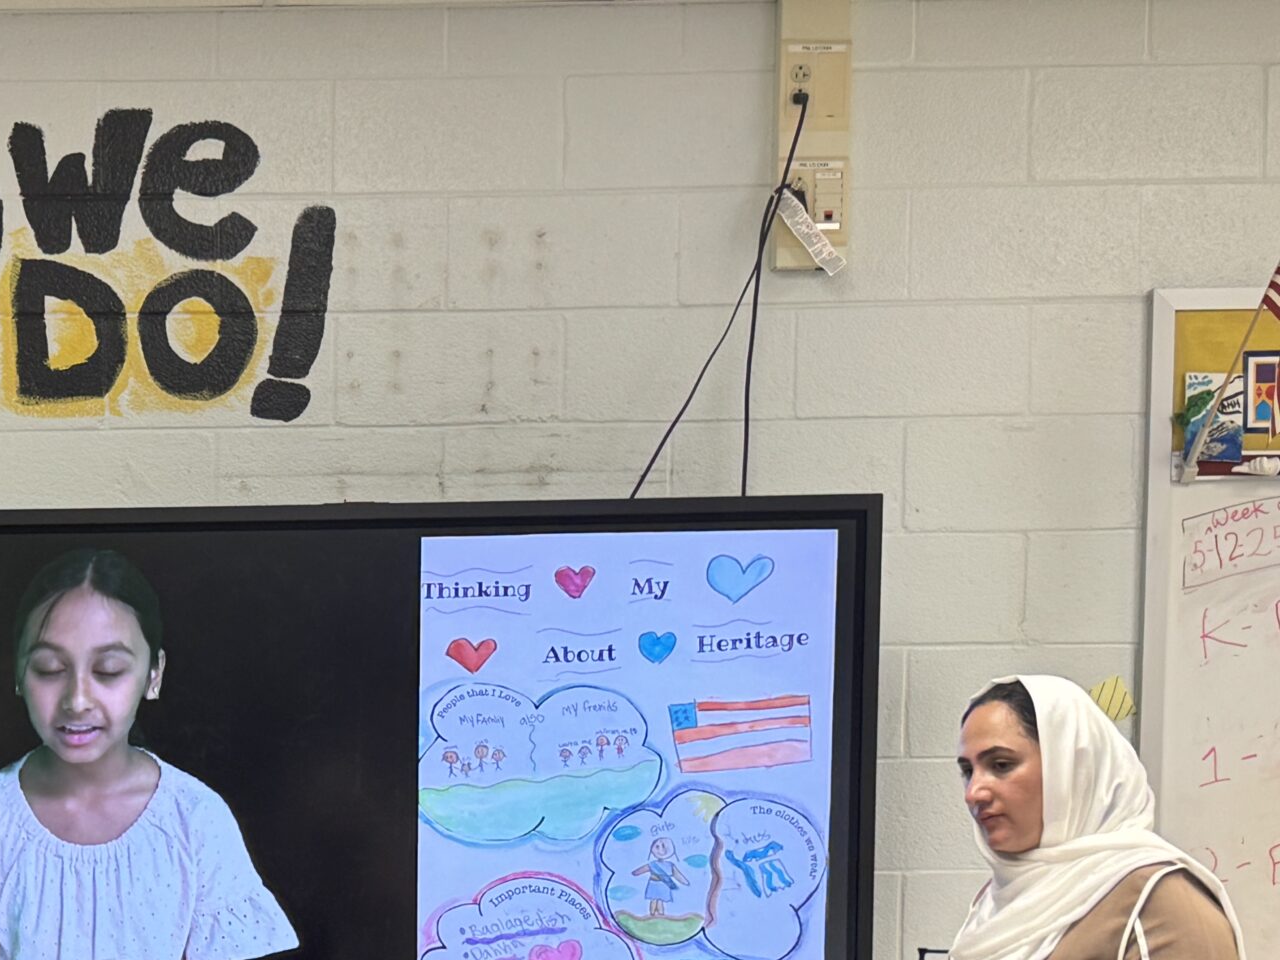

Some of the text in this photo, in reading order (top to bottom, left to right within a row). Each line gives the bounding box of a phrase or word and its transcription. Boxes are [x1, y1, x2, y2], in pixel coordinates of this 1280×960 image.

[7, 107, 261, 262] We
[1211, 500, 1270, 529] Week
[422, 576, 670, 603] Thinking My
[543, 629, 810, 664] About Heritage
[437, 693, 466, 719] People
[467, 688, 489, 698] that
[498, 690, 522, 708] Love
[488, 883, 592, 920] Important Places
